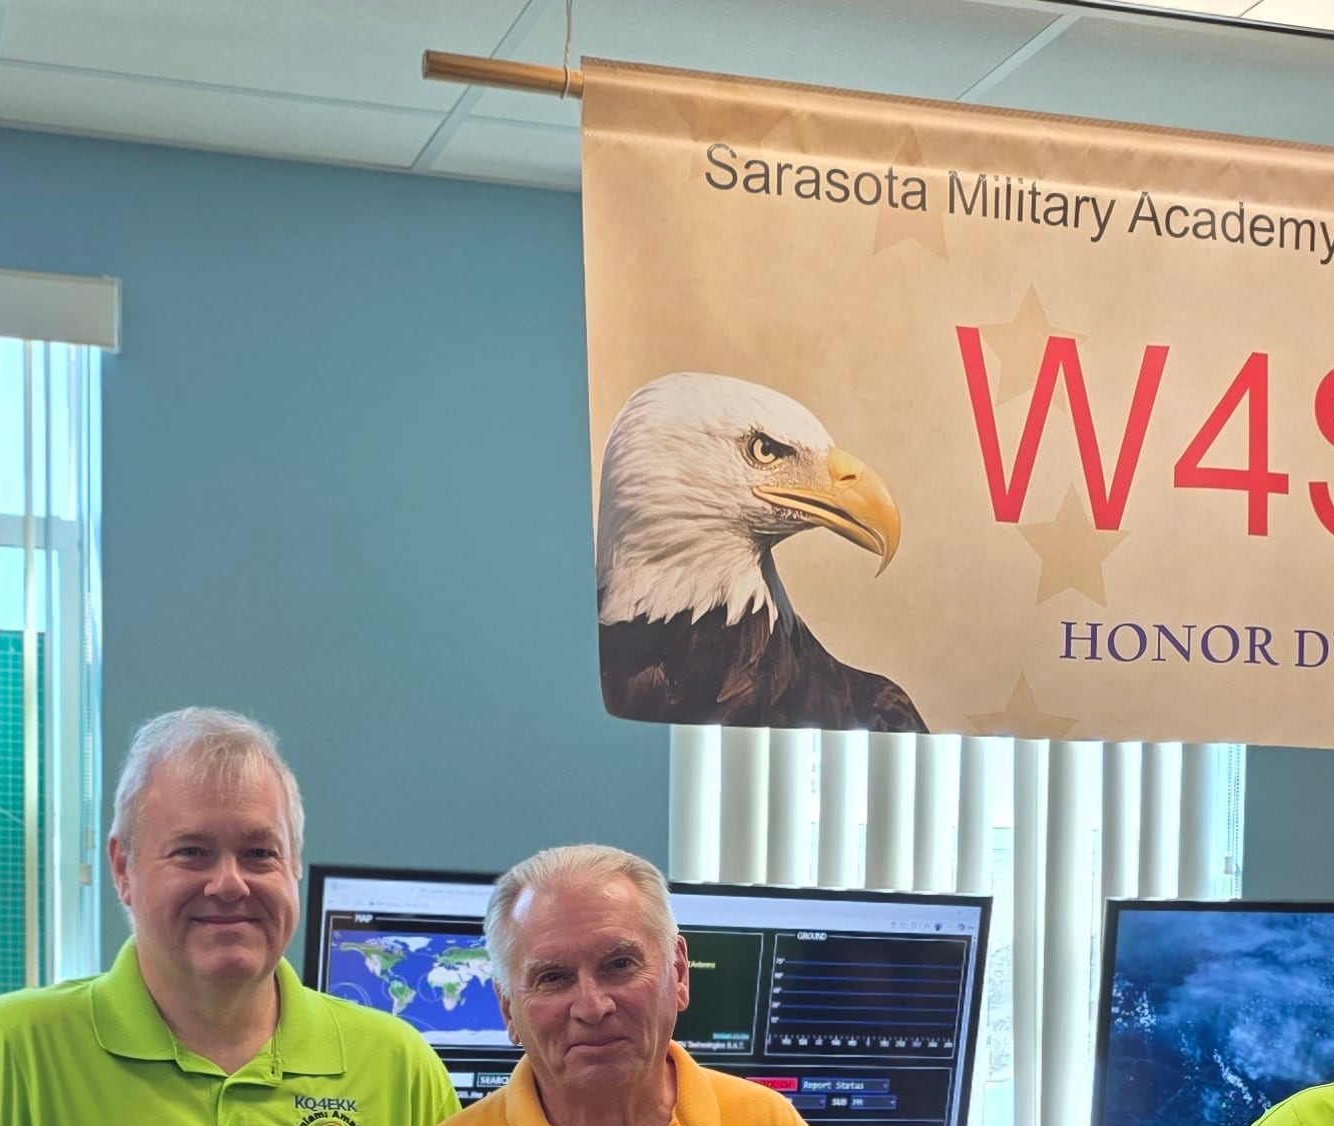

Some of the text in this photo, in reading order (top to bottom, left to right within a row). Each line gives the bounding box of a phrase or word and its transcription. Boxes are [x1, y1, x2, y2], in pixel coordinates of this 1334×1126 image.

[704, 143, 928, 211] Sarasota
[947, 169, 1117, 243] Military
[1058, 620, 1279, 668] HONOR
[480, 1075, 508, 1085] SEARC
[802, 1080, 864, 1090] Report Status
[294, 1096, 358, 1113] KQ4EKK
